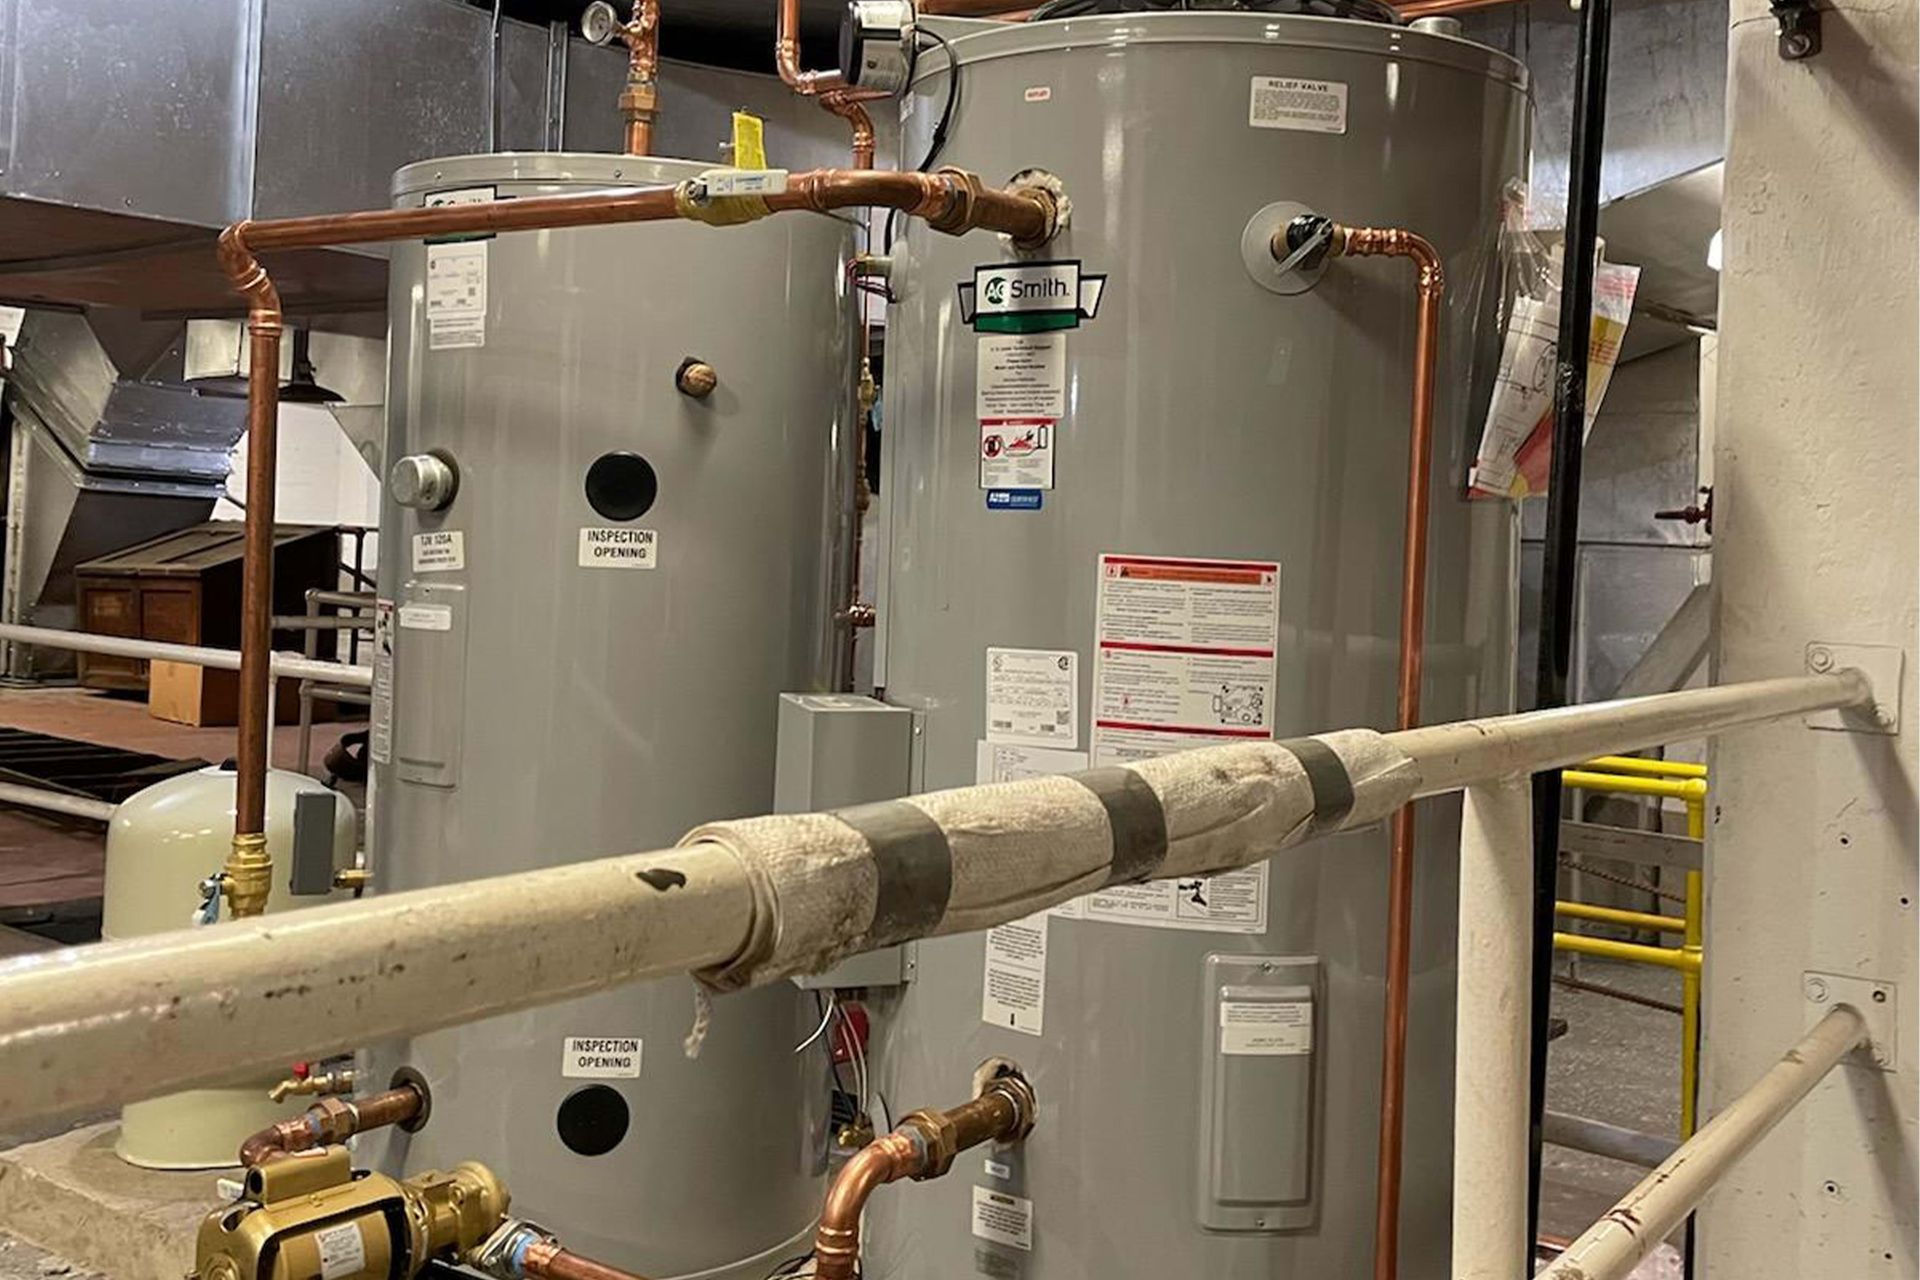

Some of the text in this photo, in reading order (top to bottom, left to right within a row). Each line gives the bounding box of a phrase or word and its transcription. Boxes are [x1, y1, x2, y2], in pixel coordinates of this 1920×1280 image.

[1268, 79, 1329, 92] RELIEF VALVE
[587, 530, 653, 543] INSPECTION
[594, 546, 647, 558] OPENING
[572, 1039, 639, 1052] INSPECTION
[578, 1056, 631, 1068] OPENING
